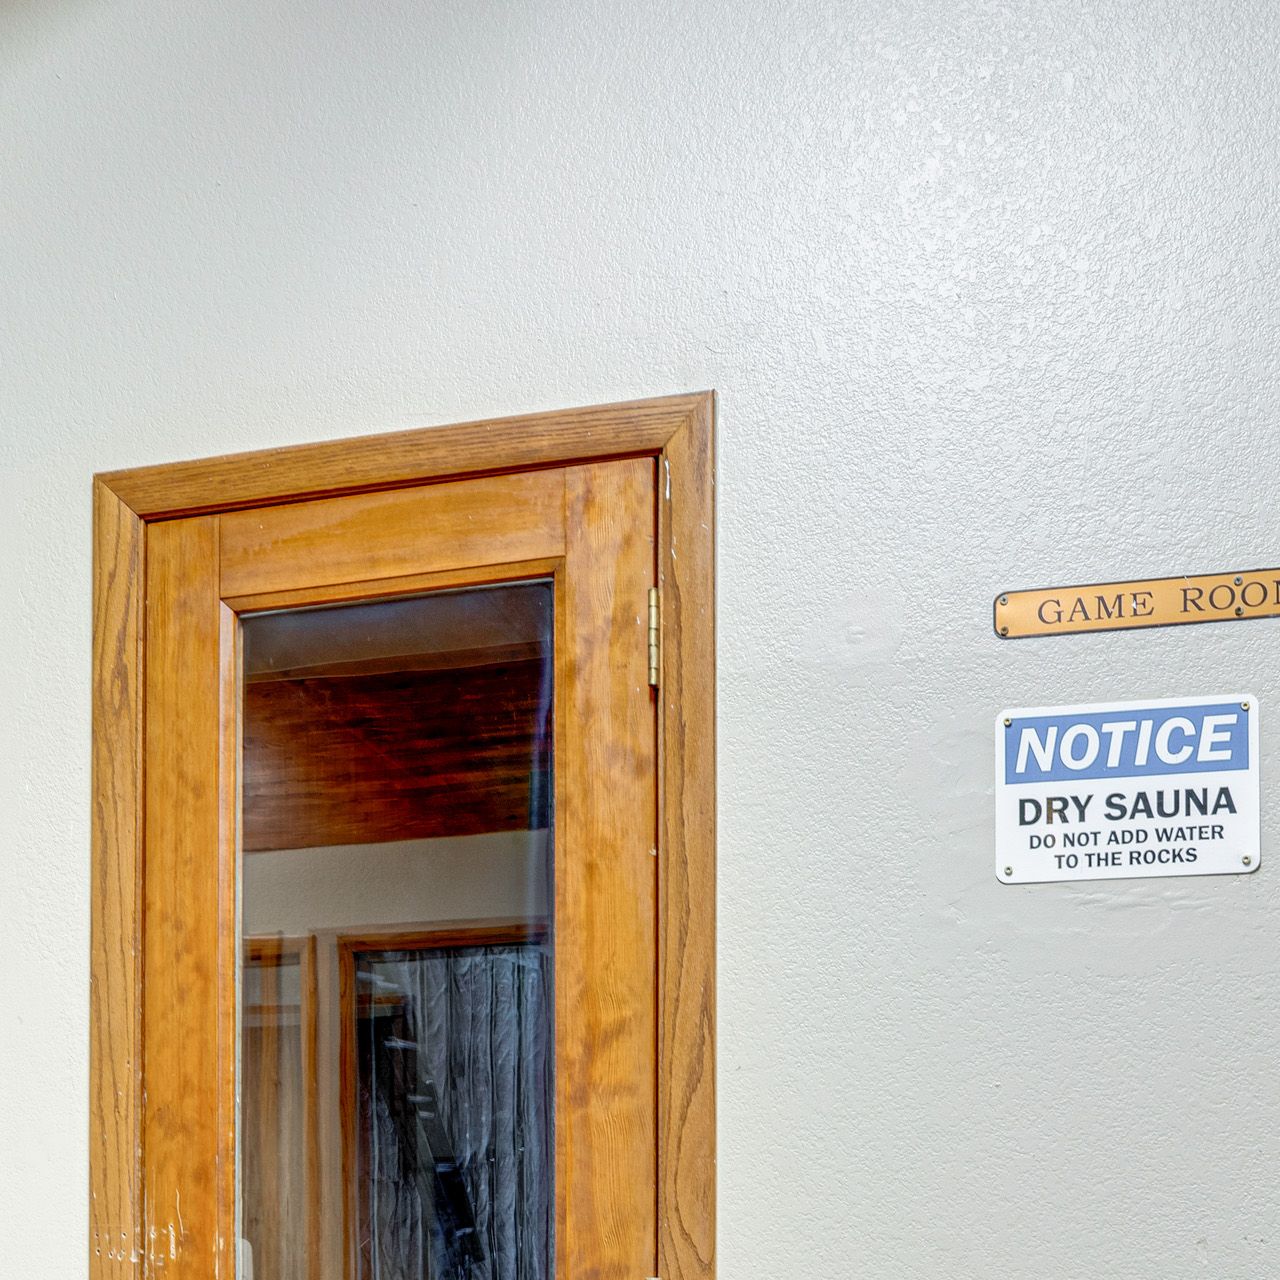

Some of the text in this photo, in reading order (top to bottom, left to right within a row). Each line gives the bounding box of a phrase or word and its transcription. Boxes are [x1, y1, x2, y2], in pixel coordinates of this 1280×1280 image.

[1038, 591, 1155, 625] GAME
[1015, 713, 1238, 774] NOTICE
[1018, 786, 1238, 826] DRY SAUNA
[1029, 825, 1225, 850] DO NOT ADD WATER
[1054, 847, 1198, 869] TO THE ROCKS
